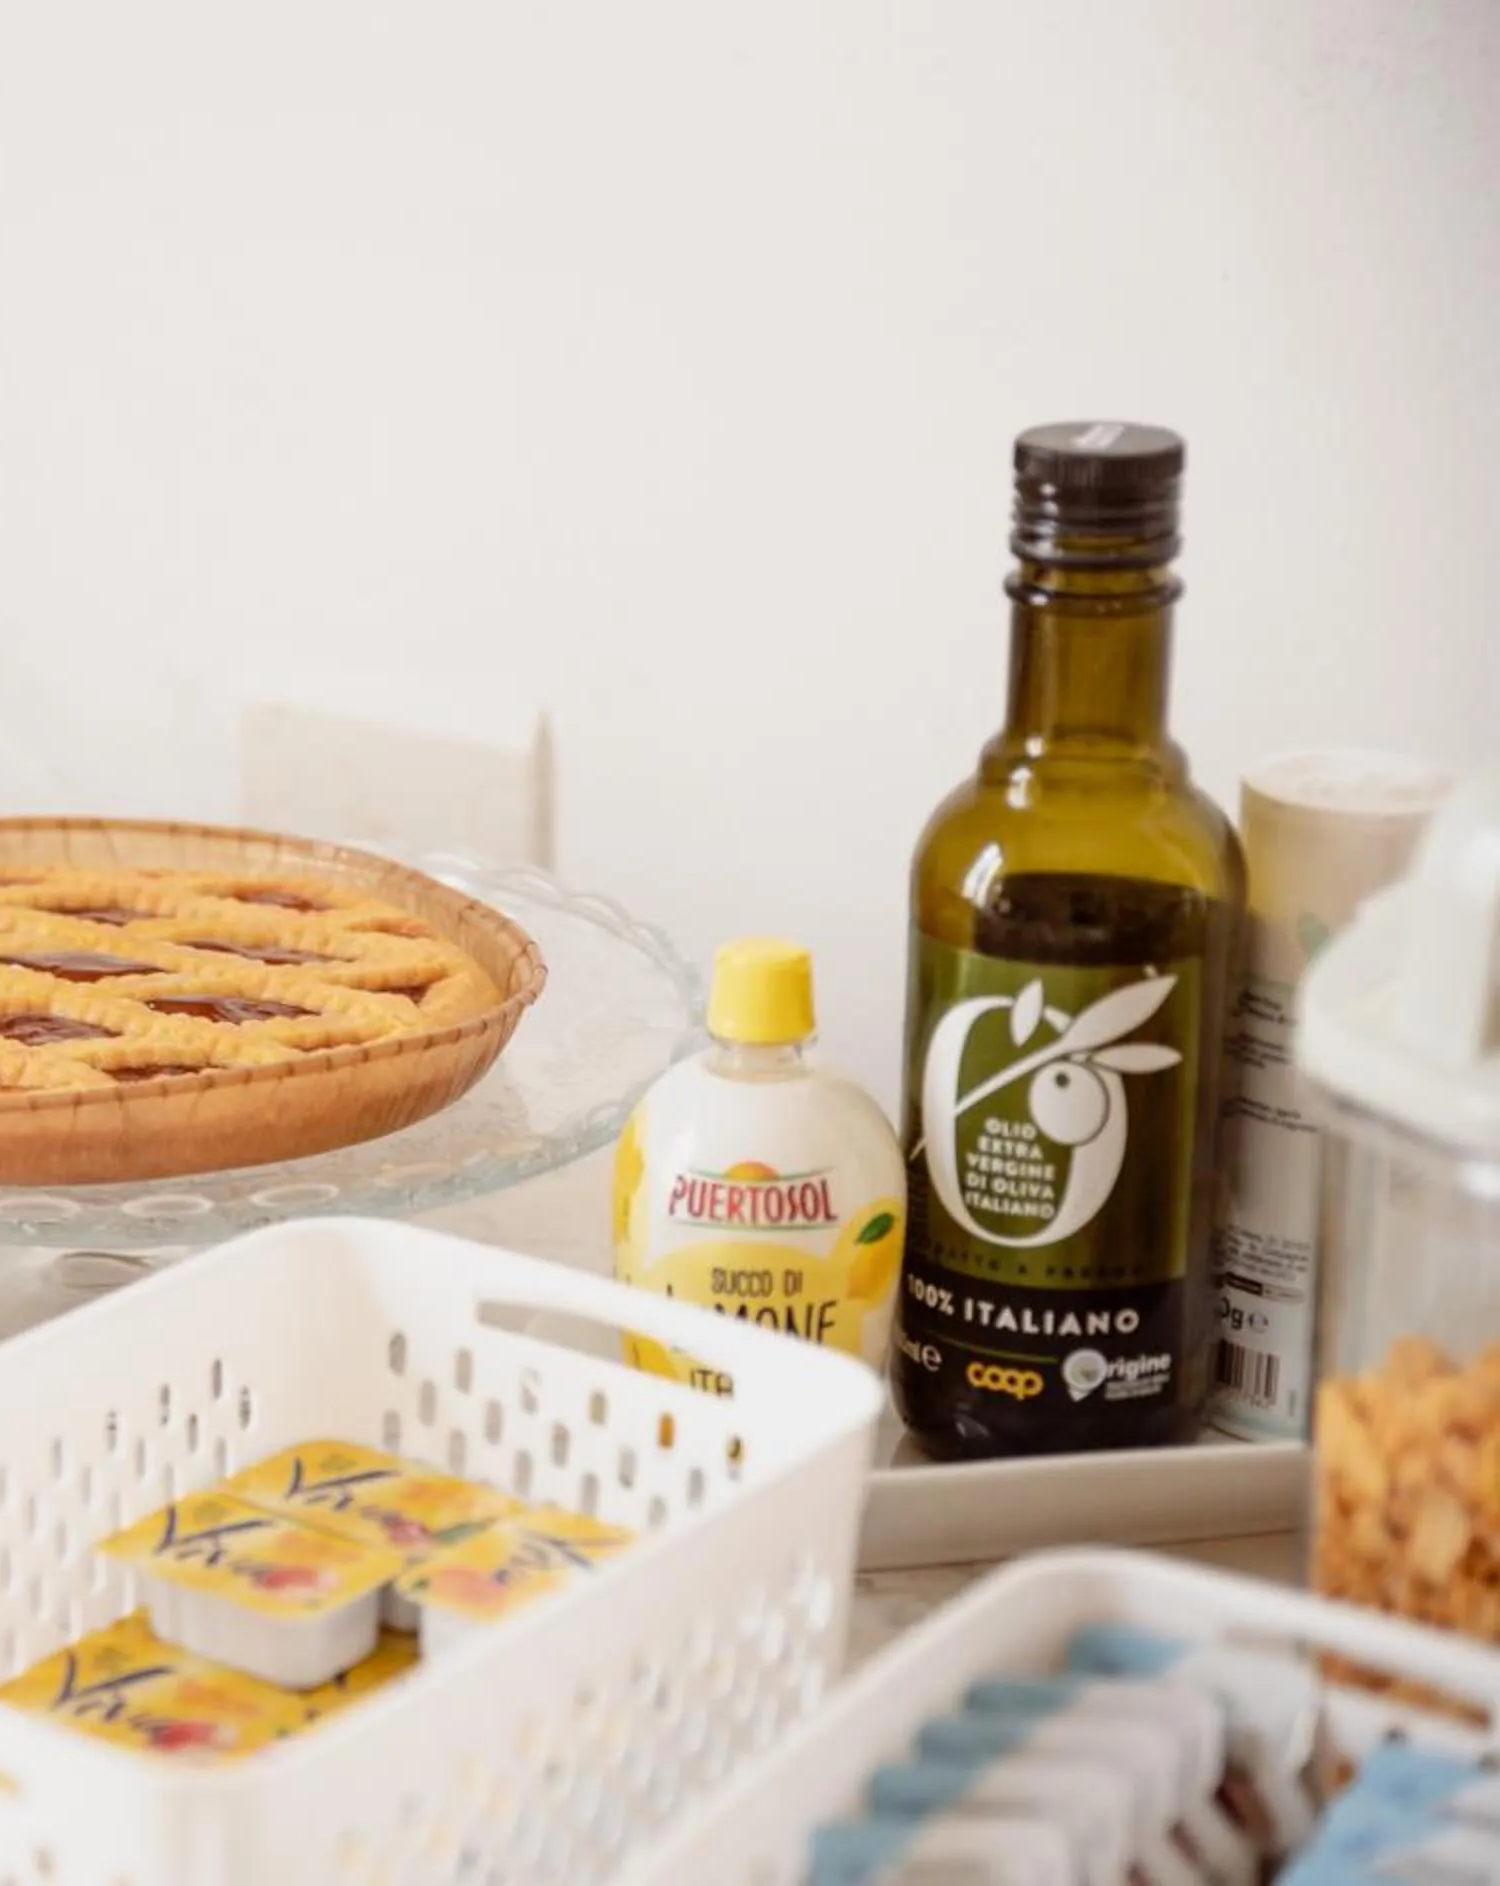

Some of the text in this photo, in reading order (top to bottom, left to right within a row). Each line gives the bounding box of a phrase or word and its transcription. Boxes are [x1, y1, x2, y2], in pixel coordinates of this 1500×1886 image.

[985, 1118, 1037, 1139] OLIO
[978, 1135, 1043, 1160] EXTRA
[965, 1151, 1055, 1181] VERGINE
[668, 1174, 839, 1224] PUERTOSOL
[966, 1171, 1055, 1200] DI OLIVA
[965, 1190, 1055, 1219] ITALIANO
[711, 1267, 803, 1298] SUCCO DI
[907, 1273, 1140, 1336] 100% ITALIANO
[966, 1361, 1044, 1400] coop
